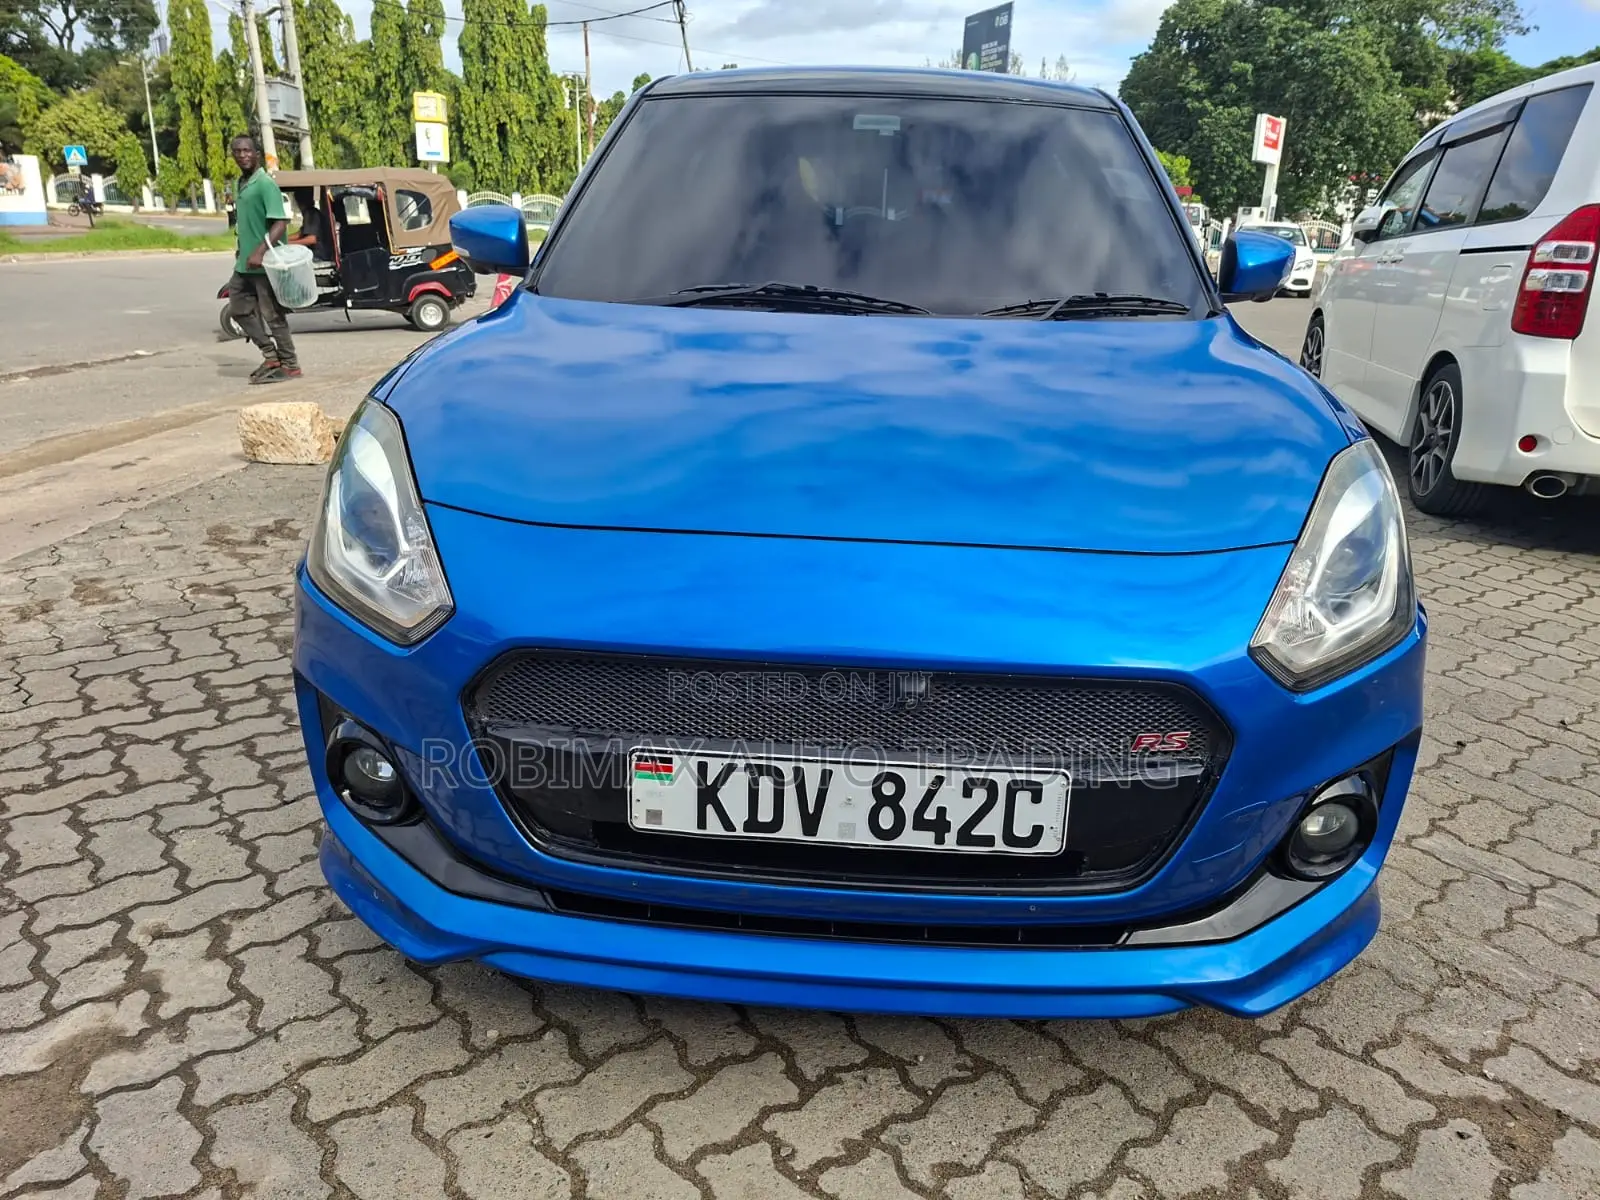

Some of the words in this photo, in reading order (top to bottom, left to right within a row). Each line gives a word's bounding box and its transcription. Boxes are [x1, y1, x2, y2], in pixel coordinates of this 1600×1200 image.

[1130, 731, 1191, 753] RS
[696, 760, 834, 837] KDV
[867, 771, 1045, 849] 842C
